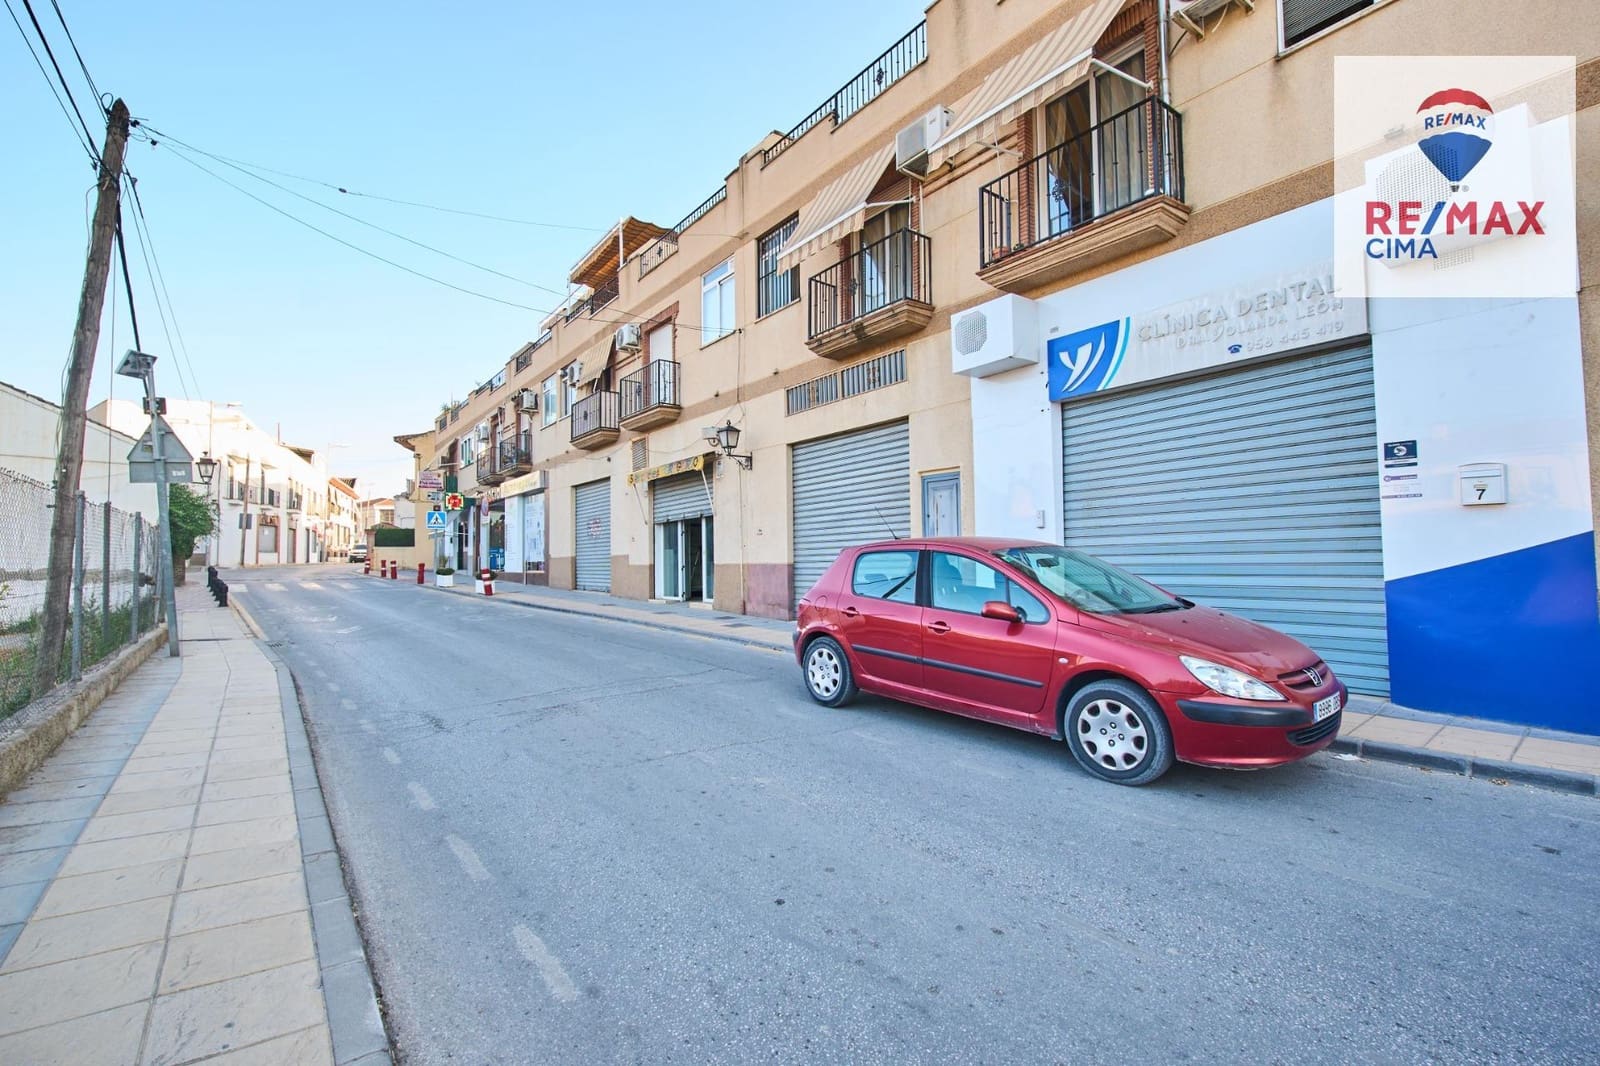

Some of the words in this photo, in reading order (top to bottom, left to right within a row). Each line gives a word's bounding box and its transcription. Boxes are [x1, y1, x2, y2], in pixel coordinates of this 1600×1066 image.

[1137, 304, 1229, 343] CLÍNICA
[1238, 274, 1343, 318] DENTAL
[1295, 297, 1345, 320] LEÓN
[1475, 488, 1487, 500] 7
